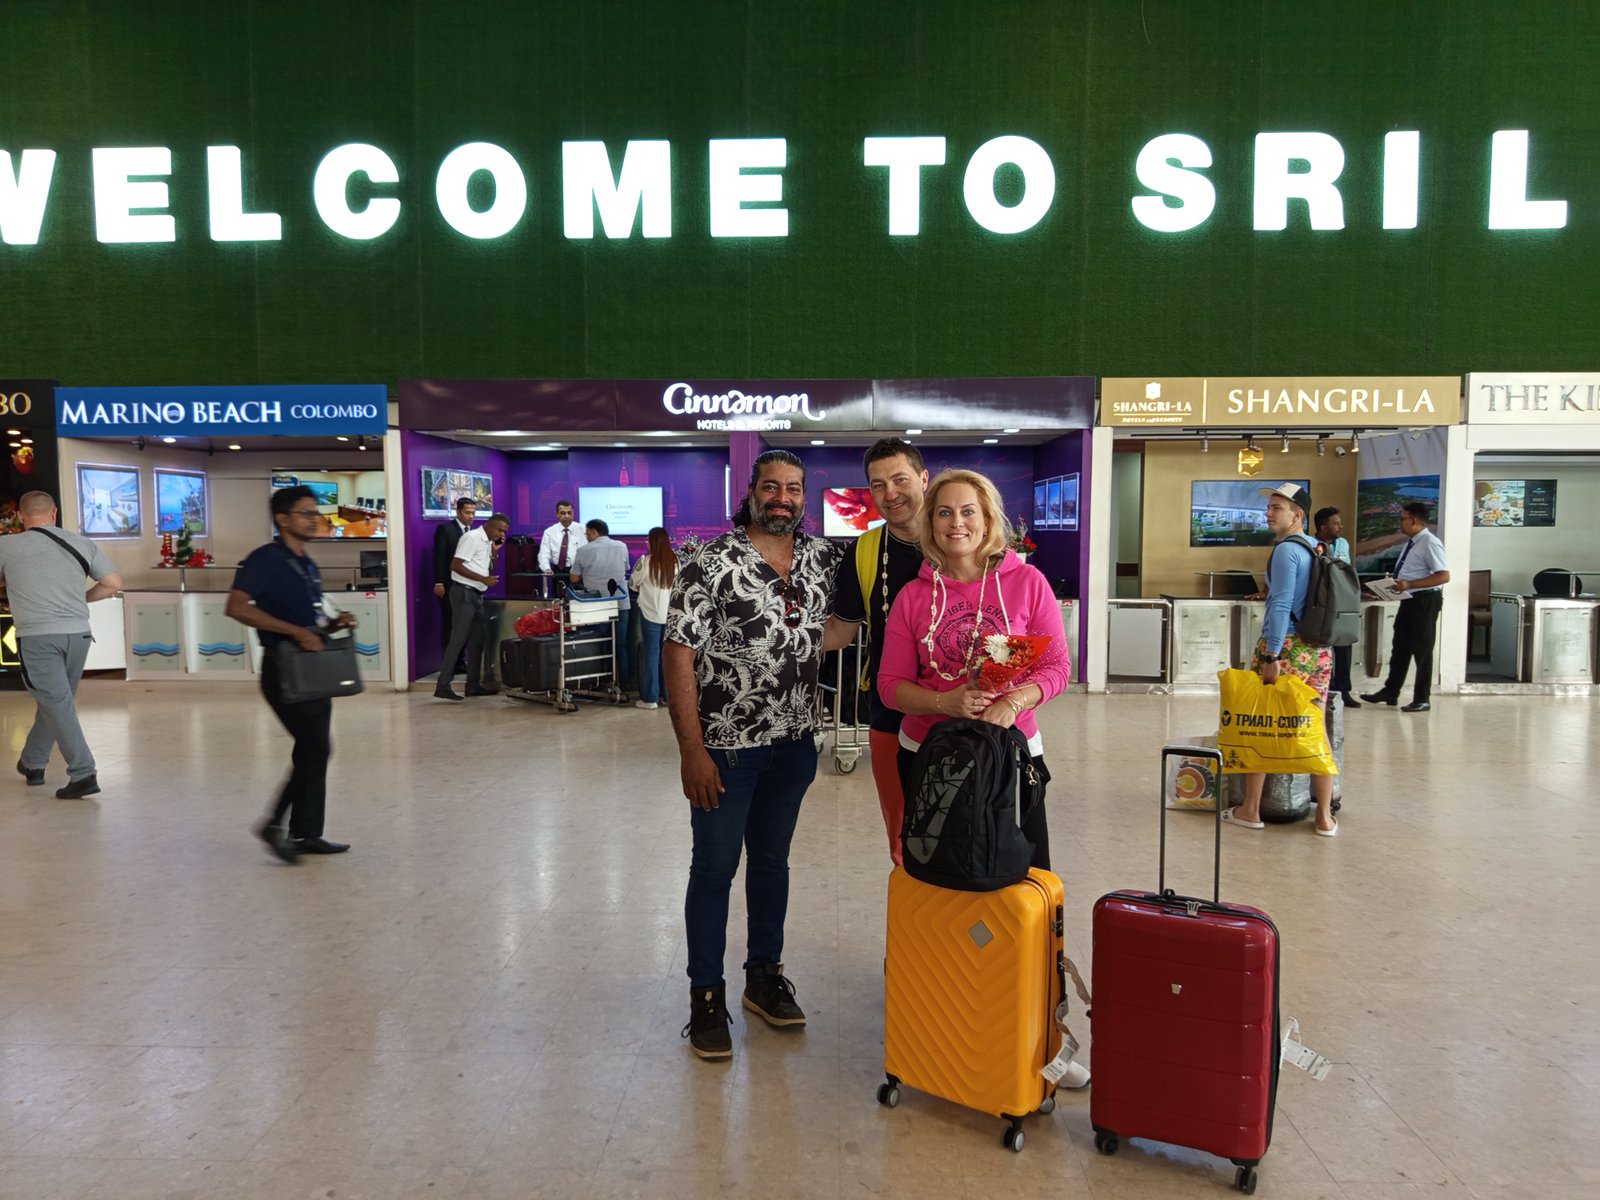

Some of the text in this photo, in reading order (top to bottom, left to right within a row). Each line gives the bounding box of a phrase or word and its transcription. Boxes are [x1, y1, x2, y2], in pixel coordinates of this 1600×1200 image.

[864, 135, 1056, 236] TO
[1131, 130, 1420, 233] SRI
[1488, 129, 1568, 230] L
[662, 382, 827, 422] Cinnamon
[1112, 401, 1192, 412] SHANGRI-LA
[1227, 388, 1436, 414] SHANGRI-LA
[1480, 384, 1549, 412] THE
[61, 400, 378, 425] MARINO BEACH COLOMBO
[697, 419, 734, 430] HOTELS
[1235, 713, 1312, 729] ТРИАЛ-СПОРТ
